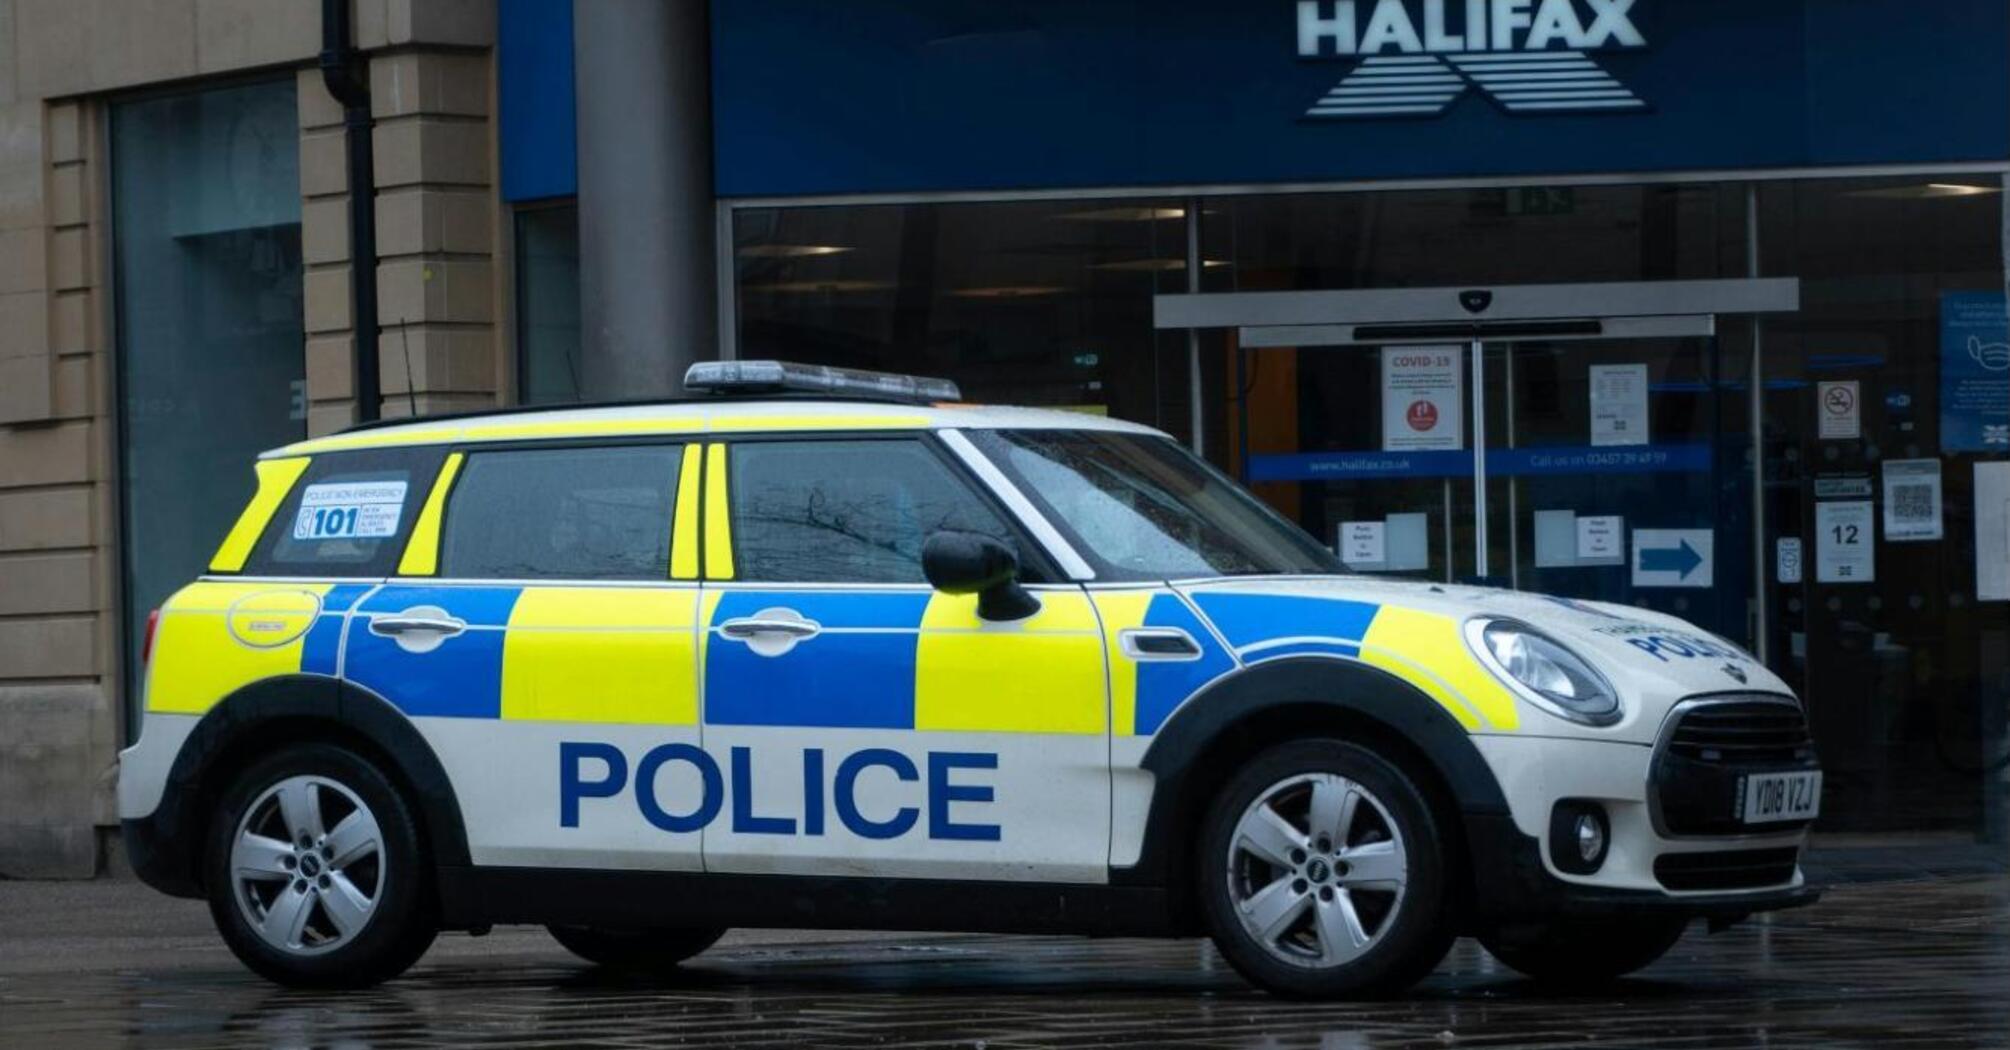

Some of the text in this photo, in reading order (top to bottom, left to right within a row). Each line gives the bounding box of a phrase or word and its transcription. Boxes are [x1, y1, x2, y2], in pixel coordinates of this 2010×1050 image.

[1298, 0, 1648, 55] HALIFAX
[315, 508, 359, 536] 101
[1832, 525, 1859, 545] 12
[559, 741, 1001, 841] POLICE
[1787, 776, 1815, 813] VZJ
